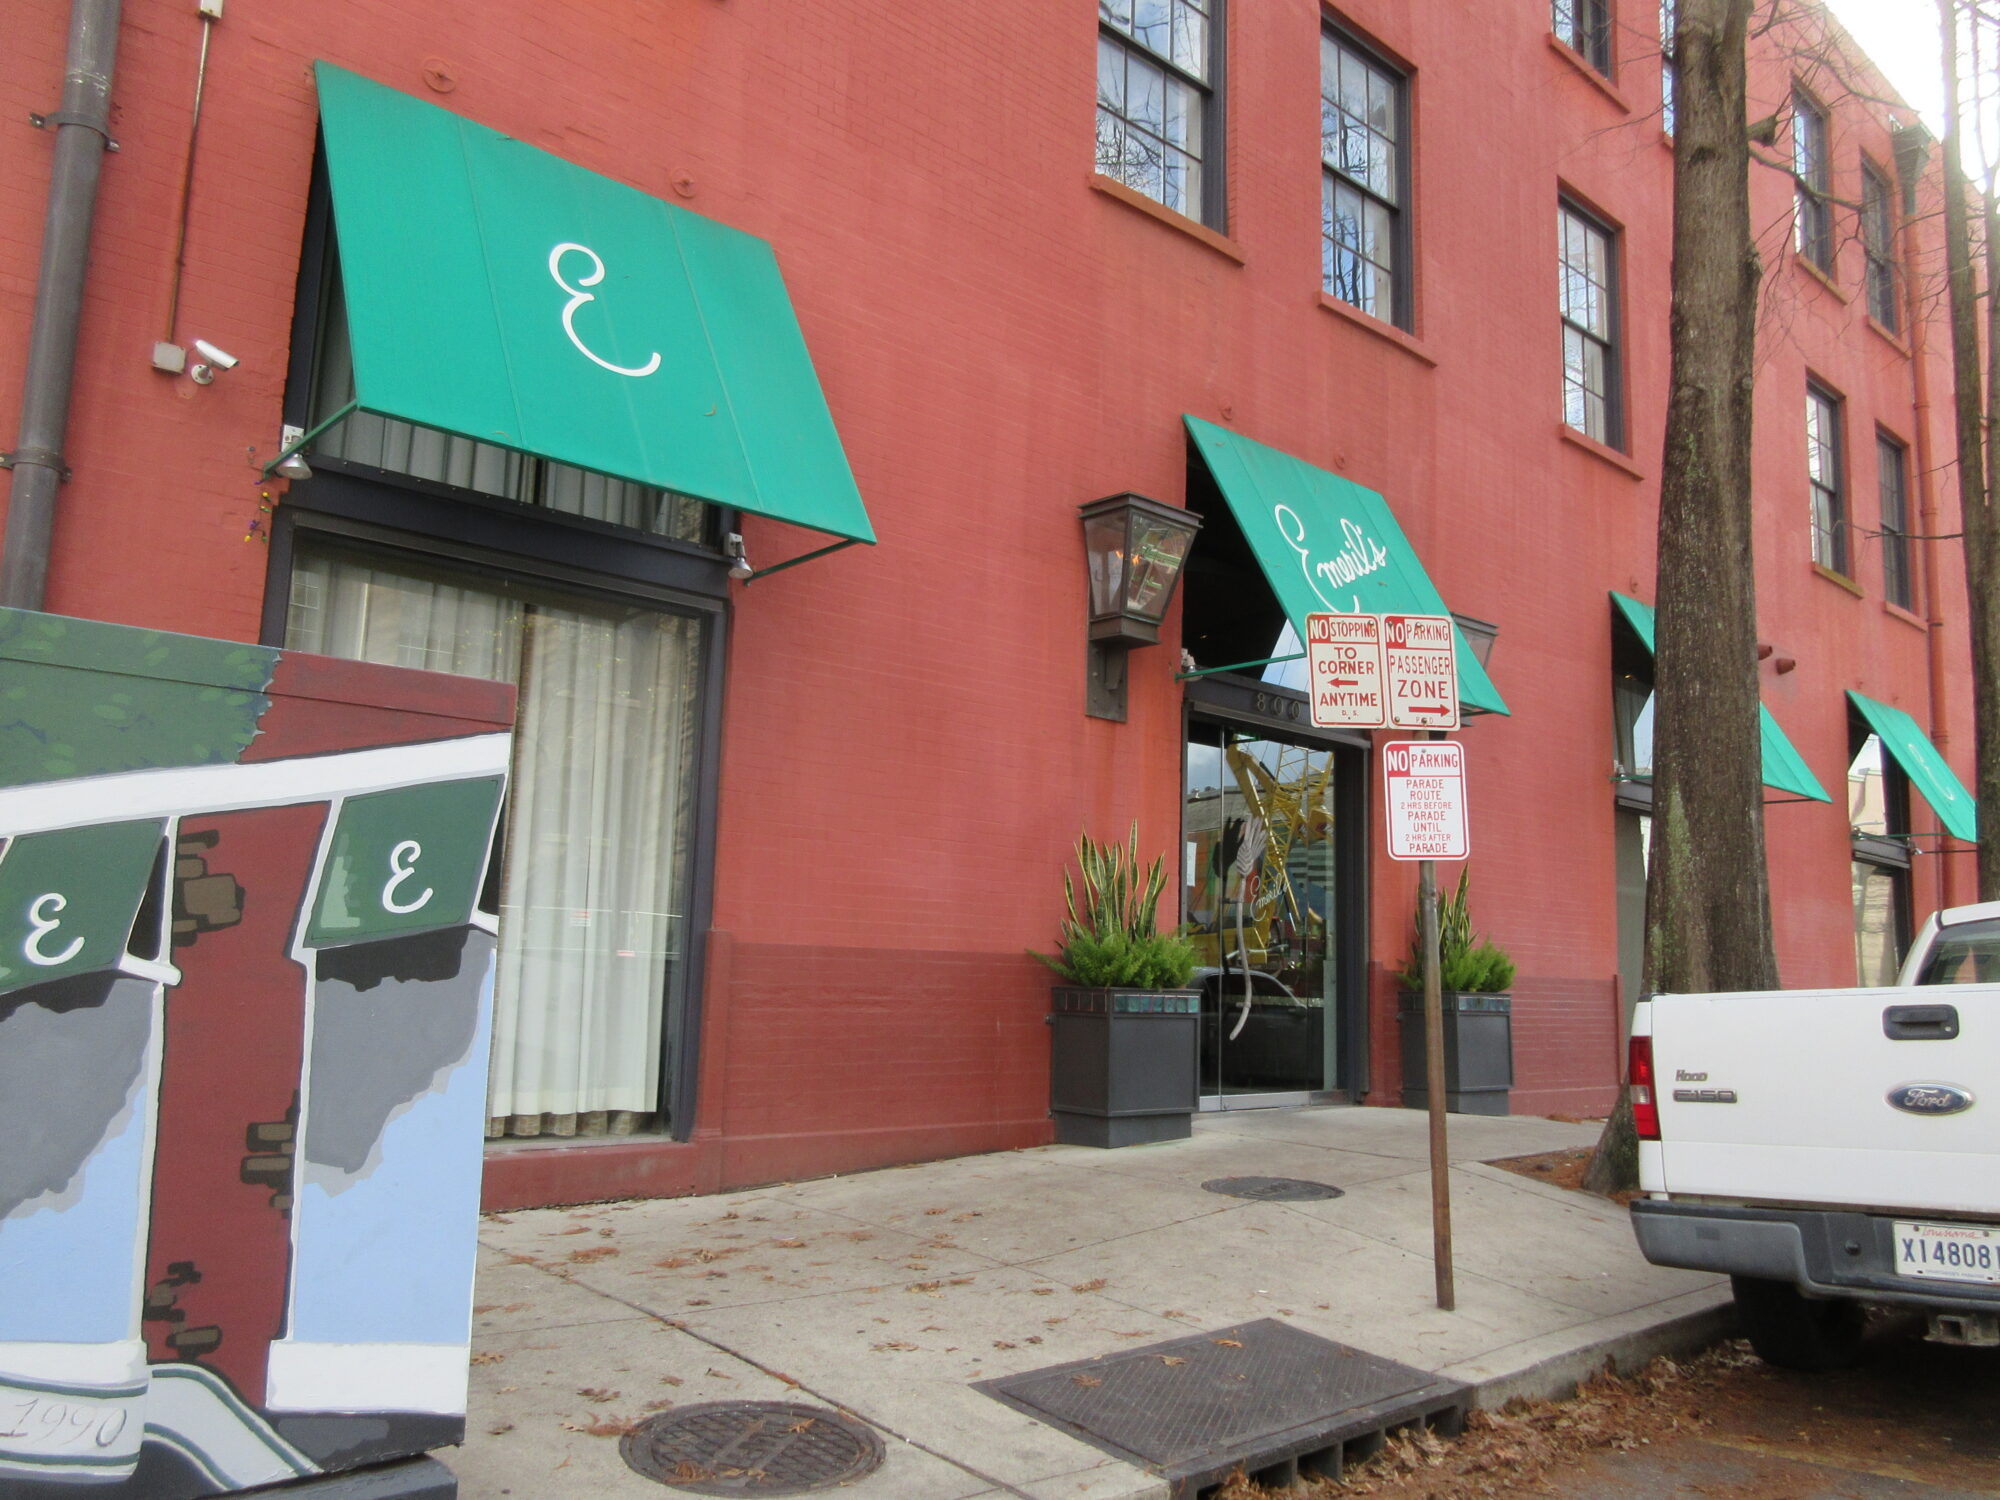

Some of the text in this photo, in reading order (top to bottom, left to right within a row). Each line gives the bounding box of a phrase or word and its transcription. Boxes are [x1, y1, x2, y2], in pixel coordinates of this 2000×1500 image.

[549, 242, 661, 377] E
[1310, 619, 1377, 640] NO STOPPING
[1386, 622, 1449, 643] NO PARKING
[1334, 647, 1357, 660] TO
[1318, 660, 1375, 675] CORNER
[1389, 655, 1451, 675] PASSENGER
[1397, 679, 1449, 699] ZONE
[1257, 692, 1300, 720] 800
[1320, 692, 1378, 707] ANYTIME
[1387, 750, 1459, 772] NO PARKING
[1406, 779, 1445, 790] PARADE
[1410, 790, 1442, 801] ROUTE
[1400, 801, 1453, 810] 2 HRS BEFORE
[1407, 810, 1447, 821] PARADE
[1413, 822, 1442, 833] UNTIL
[1405, 833, 1451, 842] 2 HRS AFTER
[1409, 843, 1449, 854] PARADE
